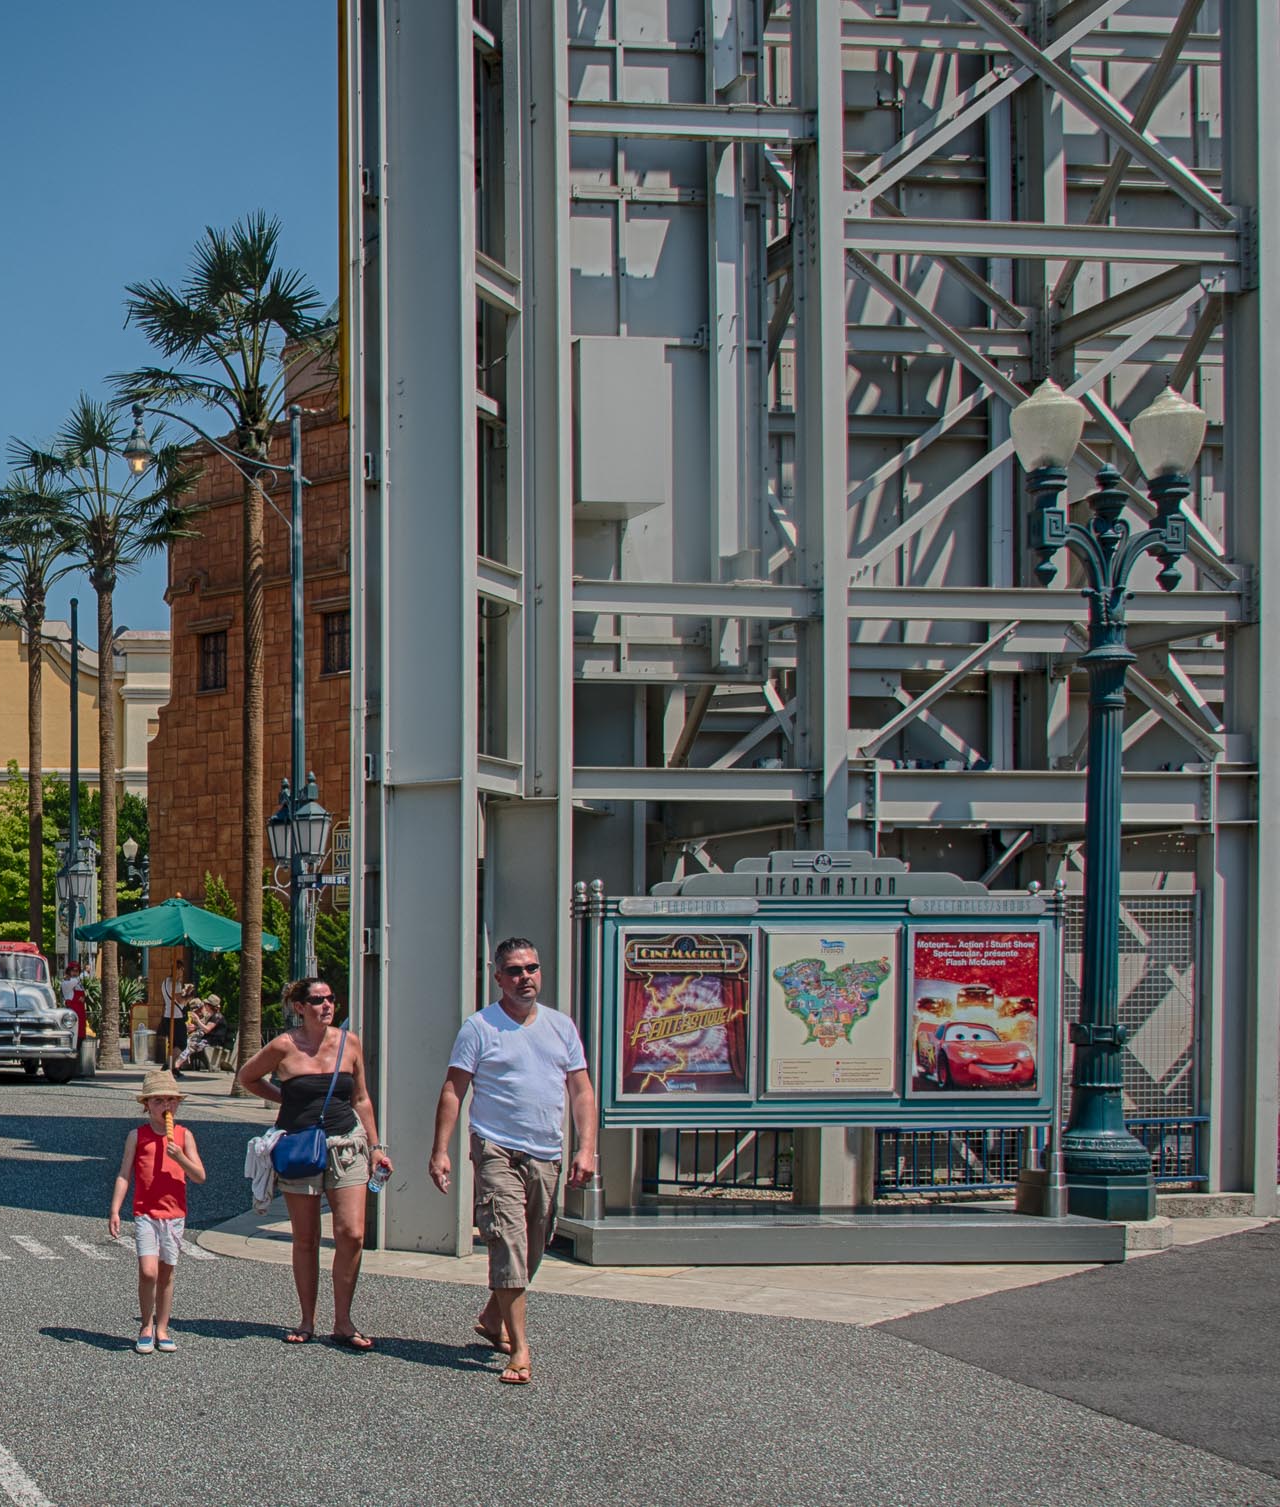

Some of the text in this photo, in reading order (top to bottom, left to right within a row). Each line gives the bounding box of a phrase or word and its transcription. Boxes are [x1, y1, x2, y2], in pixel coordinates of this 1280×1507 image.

[755, 877, 896, 896] INFORMATION
[923, 900, 1032, 912] SPECTACLES/SHOWS
[1013, 941, 1035, 949] Show
[946, 958, 1006, 967] Flash McQueen
